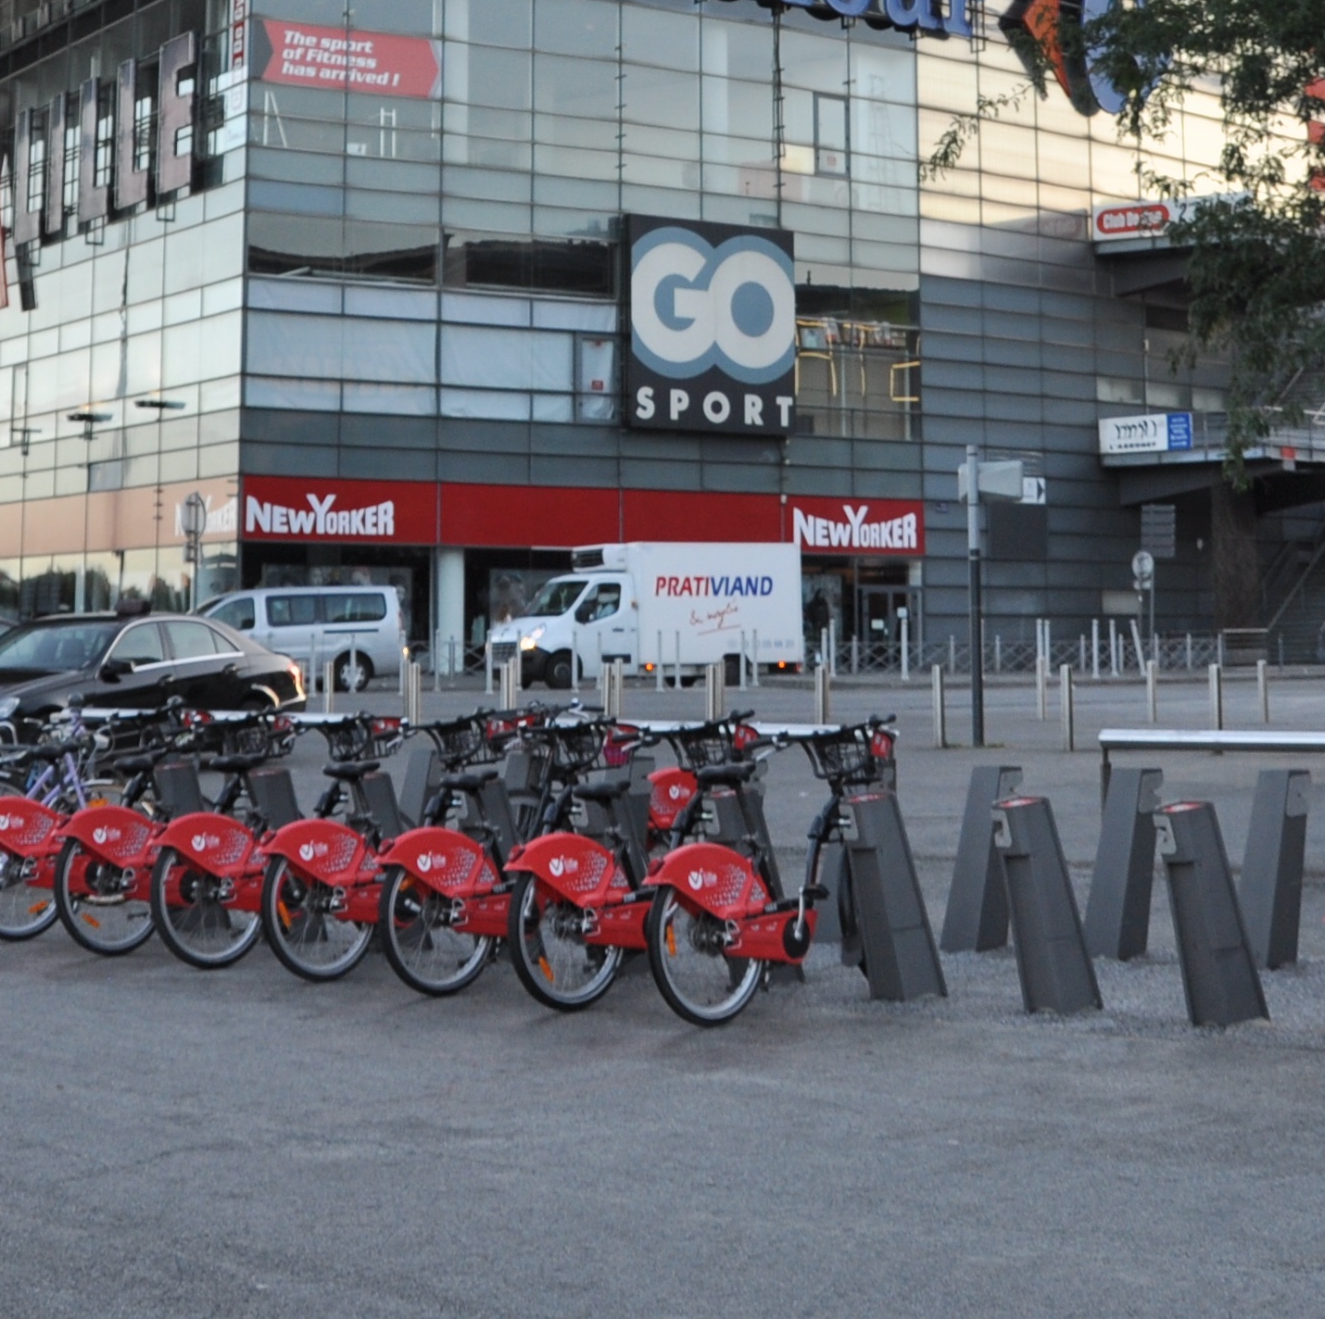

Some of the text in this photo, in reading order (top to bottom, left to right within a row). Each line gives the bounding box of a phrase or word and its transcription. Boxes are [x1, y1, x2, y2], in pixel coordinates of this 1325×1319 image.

[283, 30, 373, 54] The sport
[282, 47, 377, 68] of Fitness
[282, 61, 316, 77] has
[319, 66, 389, 86] arrived
[631, 242, 795, 369] GO
[636, 386, 793, 427] SPORT
[655, 576, 774, 598] PRATIVIAND
